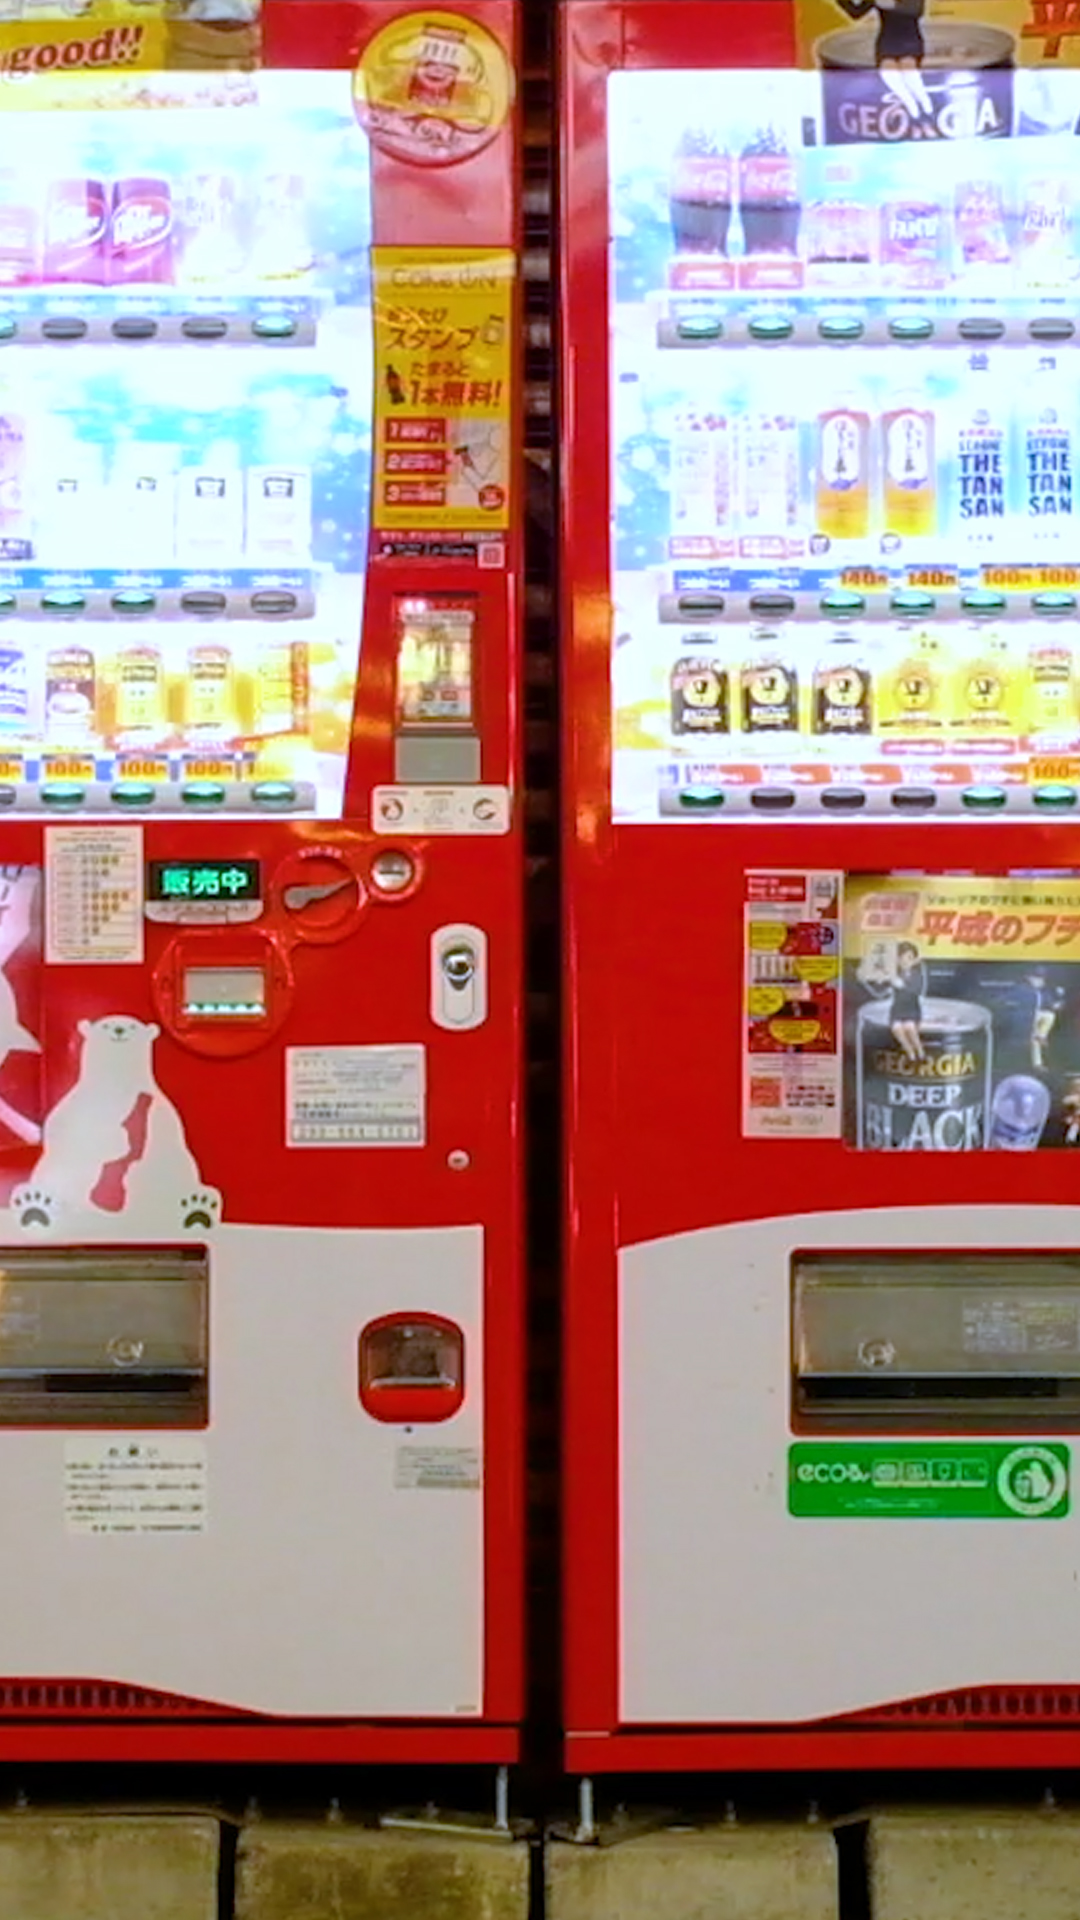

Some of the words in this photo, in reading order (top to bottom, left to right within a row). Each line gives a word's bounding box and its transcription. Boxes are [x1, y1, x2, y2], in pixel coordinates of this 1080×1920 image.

[386, 326, 479, 350] スタンプ
[958, 453, 1001, 473] THE
[1027, 451, 1071, 472] THE
[958, 475, 1003, 496] TAN
[1027, 473, 1072, 494] TAN
[959, 497, 1004, 519] SAN
[1028, 495, 1072, 518] SAN
[162, 868, 247, 895] 販売中
[888, 1083, 963, 1106] DEEP
[867, 1103, 983, 1149] BLACK
